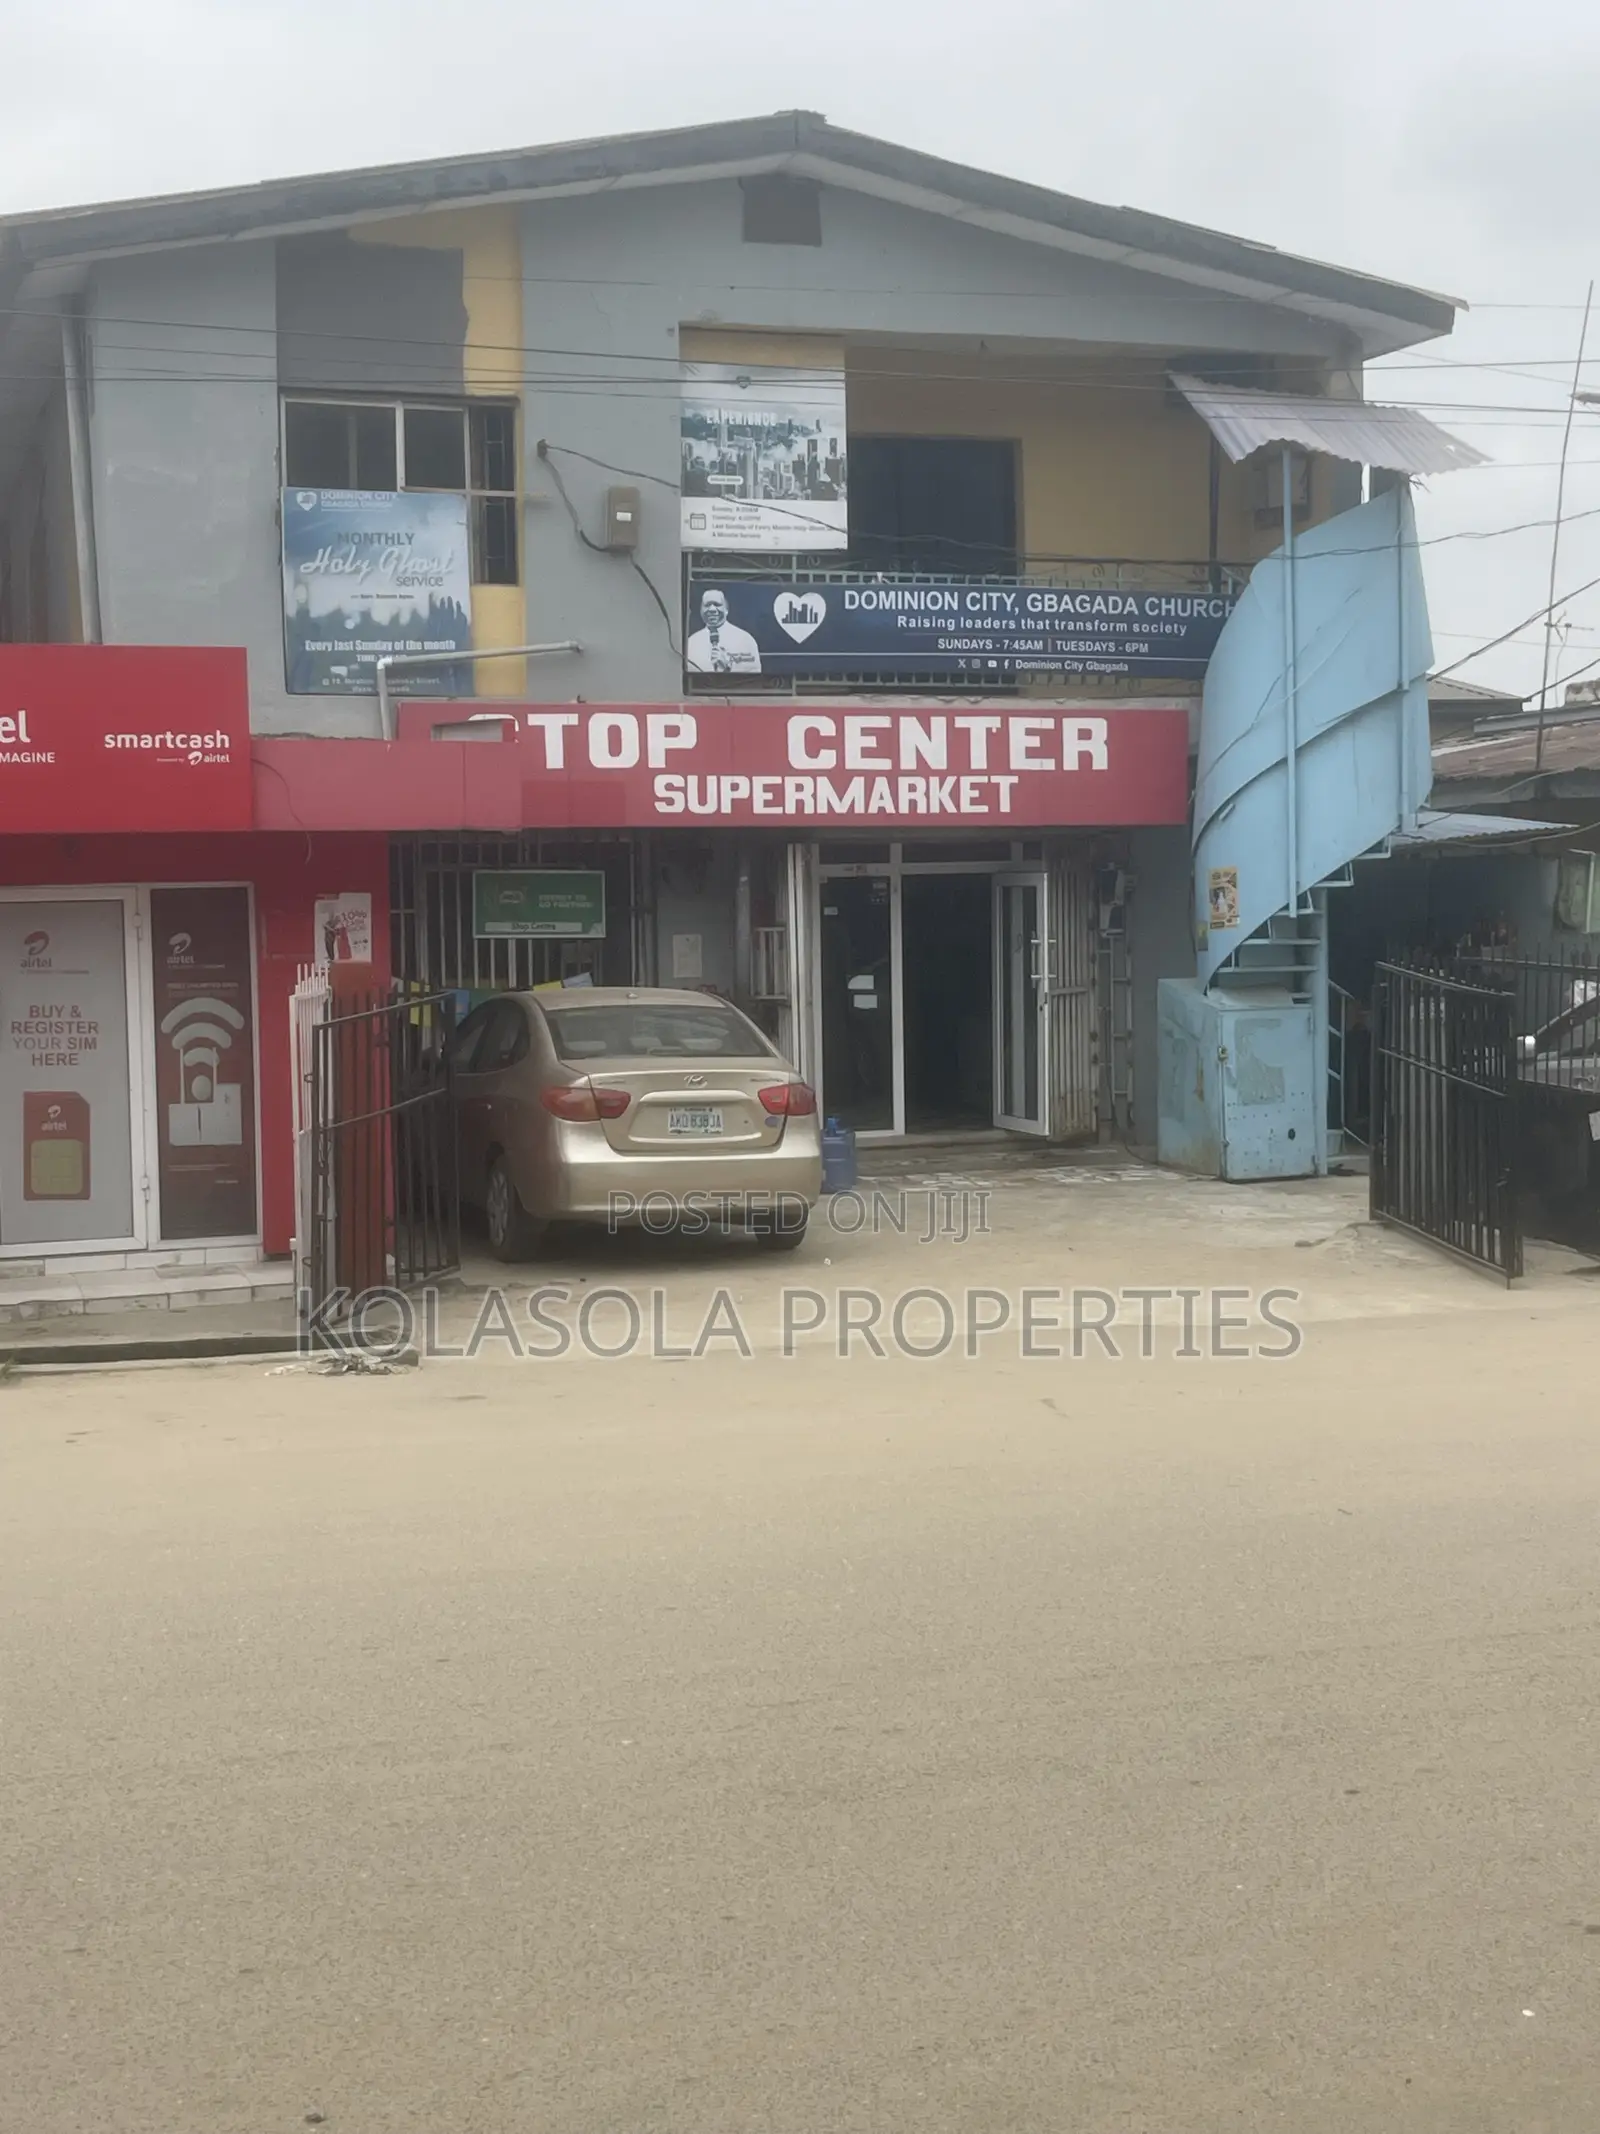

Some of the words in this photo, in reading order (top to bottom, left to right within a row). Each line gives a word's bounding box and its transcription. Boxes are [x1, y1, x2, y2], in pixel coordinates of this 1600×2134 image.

[337, 532, 415, 546] MONTHLY
[300, 546, 373, 584] Holy
[379, 547, 455, 580] Ghost
[396, 574, 444, 587] service
[844, 590, 958, 611] DOMINION
[965, 592, 1020, 616] CITY,
[1026, 593, 1138, 615] GBAGADA
[897, 615, 956, 631] Raising
[960, 617, 1016, 630] leaders
[1021, 619, 1050, 631] that
[1054, 619, 1128, 633] transform
[1132, 621, 1187, 636] society
[304, 640, 332, 652] Every
[334, 640, 354, 651] last
[355, 640, 393, 652] Sunday
[394, 641, 404, 651] of
[406, 641, 422, 651] the
[423, 641, 456, 651] month
[937, 638, 993, 650] SUNDAYS
[1002, 638, 1044, 651] 7:45AM
[1056, 640, 1116, 653] TUESDAYS
[1125, 642, 1149, 654] 6PM
[1015, 659, 1062, 671] Dominion
[1064, 660, 1084, 673] City
[1085, 661, 1129, 674] Gbagada
[104, 729, 230, 748] smartcash
[467, 713, 697, 769] TOP
[787, 715, 1108, 771] CENTER
[203, 753, 230, 763] airtel
[653, 774, 1018, 815] SUPERMARKET
[20, 957, 52, 968] airtel
[166, 953, 196, 964] airtel
[29, 1004, 65, 1018] BUY
[70, 1004, 82, 1018] &
[10, 1021, 99, 1035] REGISTER
[12, 1036, 62, 1051] YOUR
[67, 1036, 97, 1051] SIM
[31, 1052, 79, 1067] HERE
[41, 1120, 68, 1131] airtel
